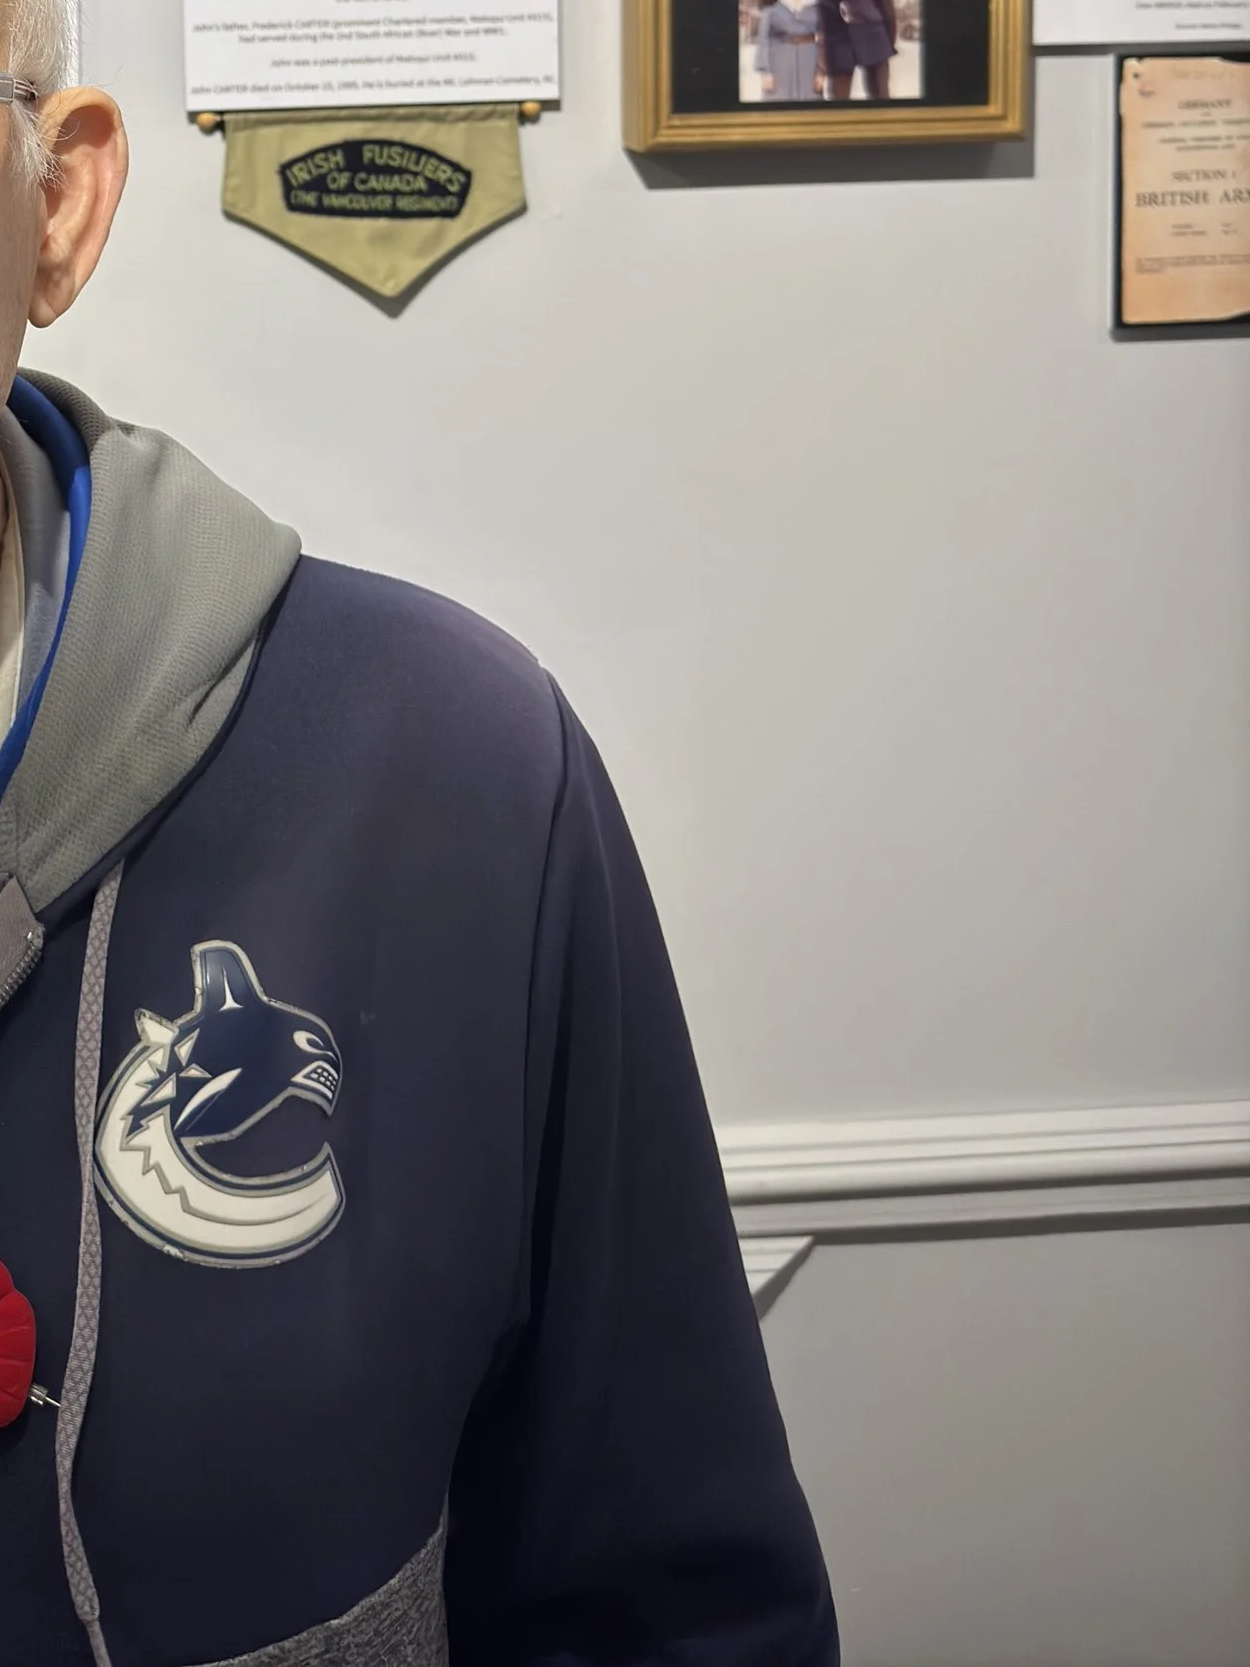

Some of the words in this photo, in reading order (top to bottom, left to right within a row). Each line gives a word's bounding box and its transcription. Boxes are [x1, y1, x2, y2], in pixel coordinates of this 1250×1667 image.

[285, 148, 345, 188] IRISH
[361, 143, 466, 193] FUSILIERS
[326, 171, 352, 190] OF
[354, 171, 429, 192] CANADA
[1135, 191, 1210, 209] BRITISH
